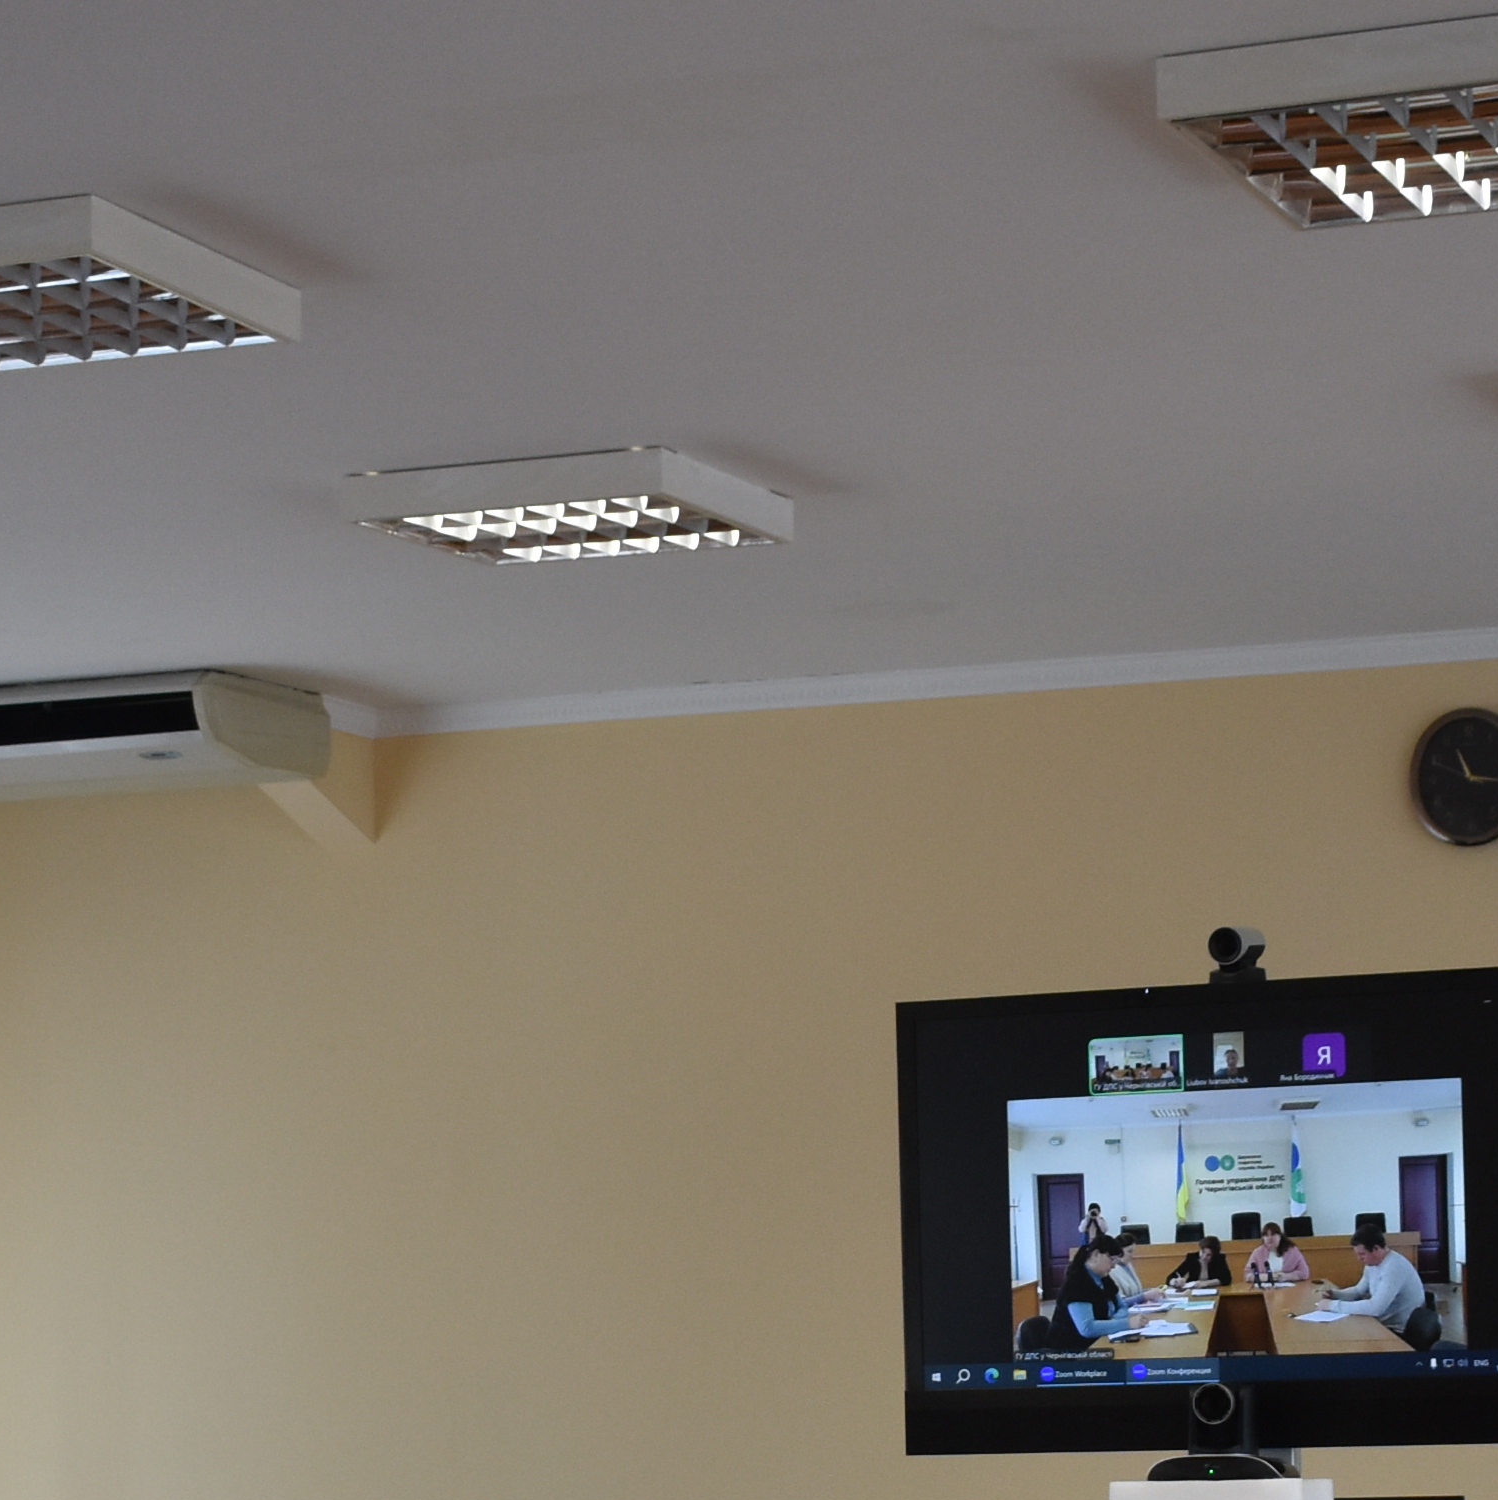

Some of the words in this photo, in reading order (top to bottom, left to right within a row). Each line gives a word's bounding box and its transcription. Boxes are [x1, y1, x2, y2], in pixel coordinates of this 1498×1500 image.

[1317, 1045, 1331, 1066] Я
[1269, 1174, 1285, 1182] ДПС
[1024, 1352, 1039, 1360] ДПС
[1473, 1359, 1489, 1367] ENG
[1074, 1370, 1107, 1378] Workplace
[1146, 1368, 1166, 1376] Zoom
